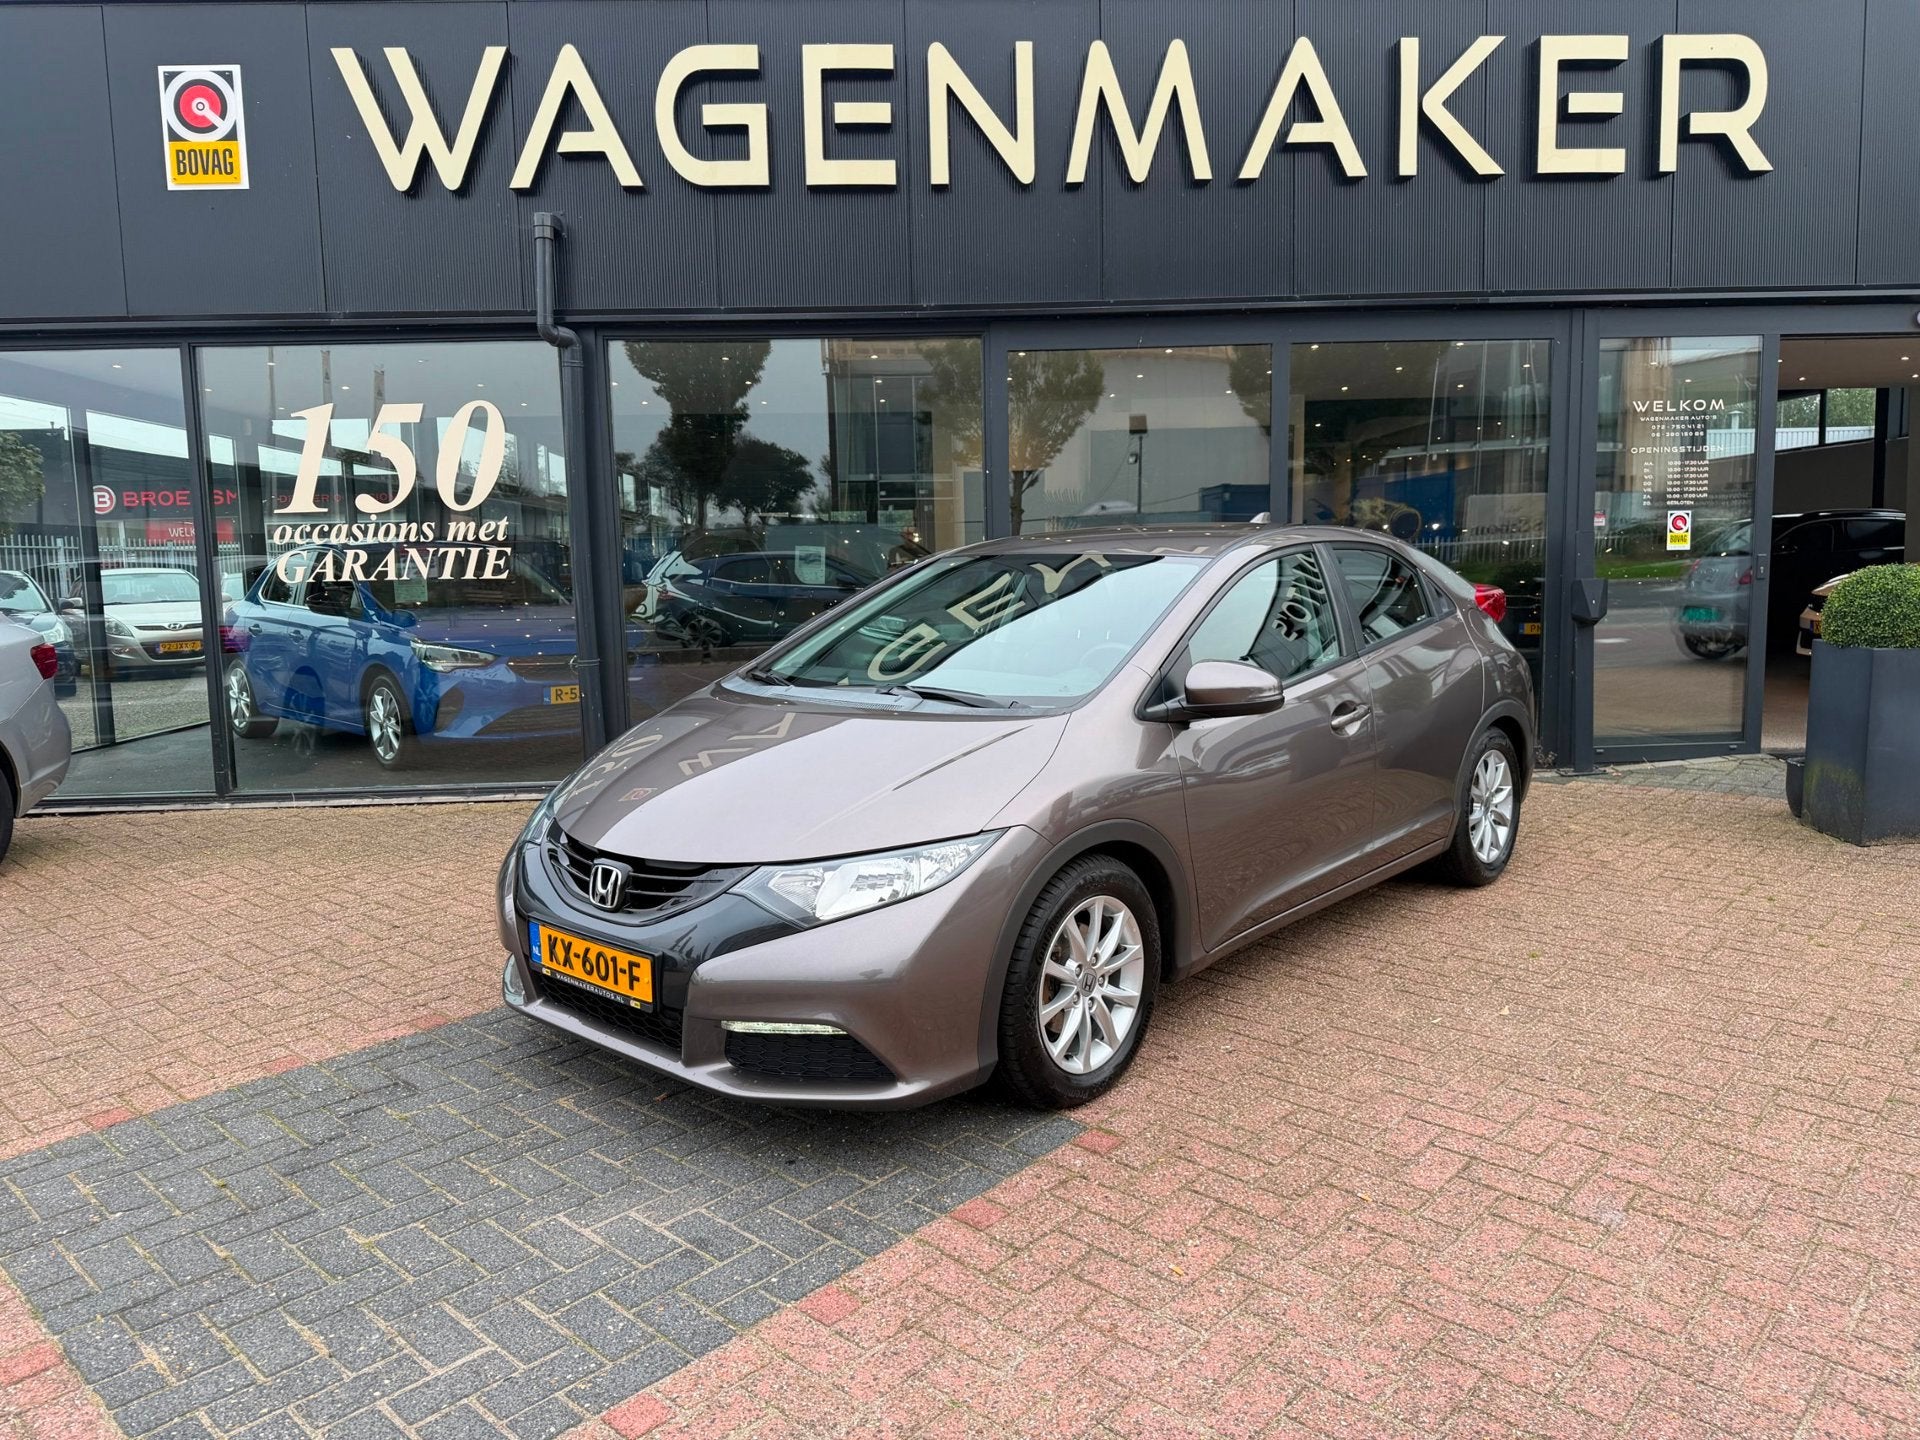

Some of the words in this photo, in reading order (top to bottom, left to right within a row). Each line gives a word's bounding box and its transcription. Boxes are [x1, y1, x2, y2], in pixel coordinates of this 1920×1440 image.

[330, 34, 1774, 192] WAGENMAKER
[175, 147, 234, 176] BOVAG
[1632, 398, 1725, 413] WELKOM
[273, 399, 507, 514] 150
[1630, 444, 1724, 454] OPENINGSTIJDEN
[273, 513, 436, 546] occasions
[446, 515, 509, 542] met
[276, 546, 512, 584] GARANTIE
[532, 945, 541, 957] NL
[547, 933, 641, 991] KX-601-F
[556, 972, 625, 1003] WAGENMAKERAUTOS.NL
